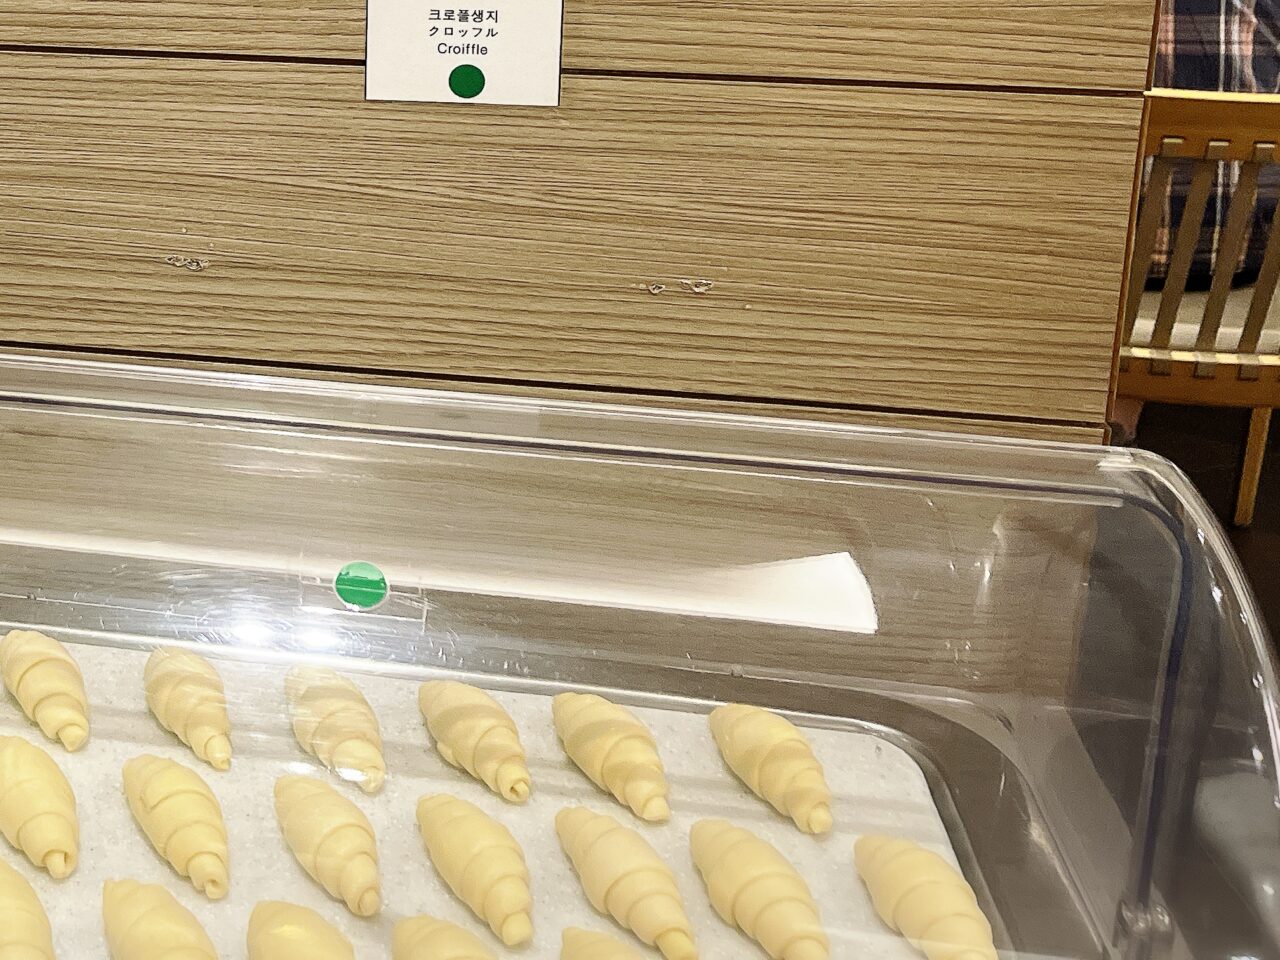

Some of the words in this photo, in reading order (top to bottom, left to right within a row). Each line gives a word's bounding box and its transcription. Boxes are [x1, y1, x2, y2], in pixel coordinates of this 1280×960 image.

[428, 9, 498, 23] 크로플생지
[429, 26, 498, 37] クロッフル
[438, 43, 488, 55] Croiffle
